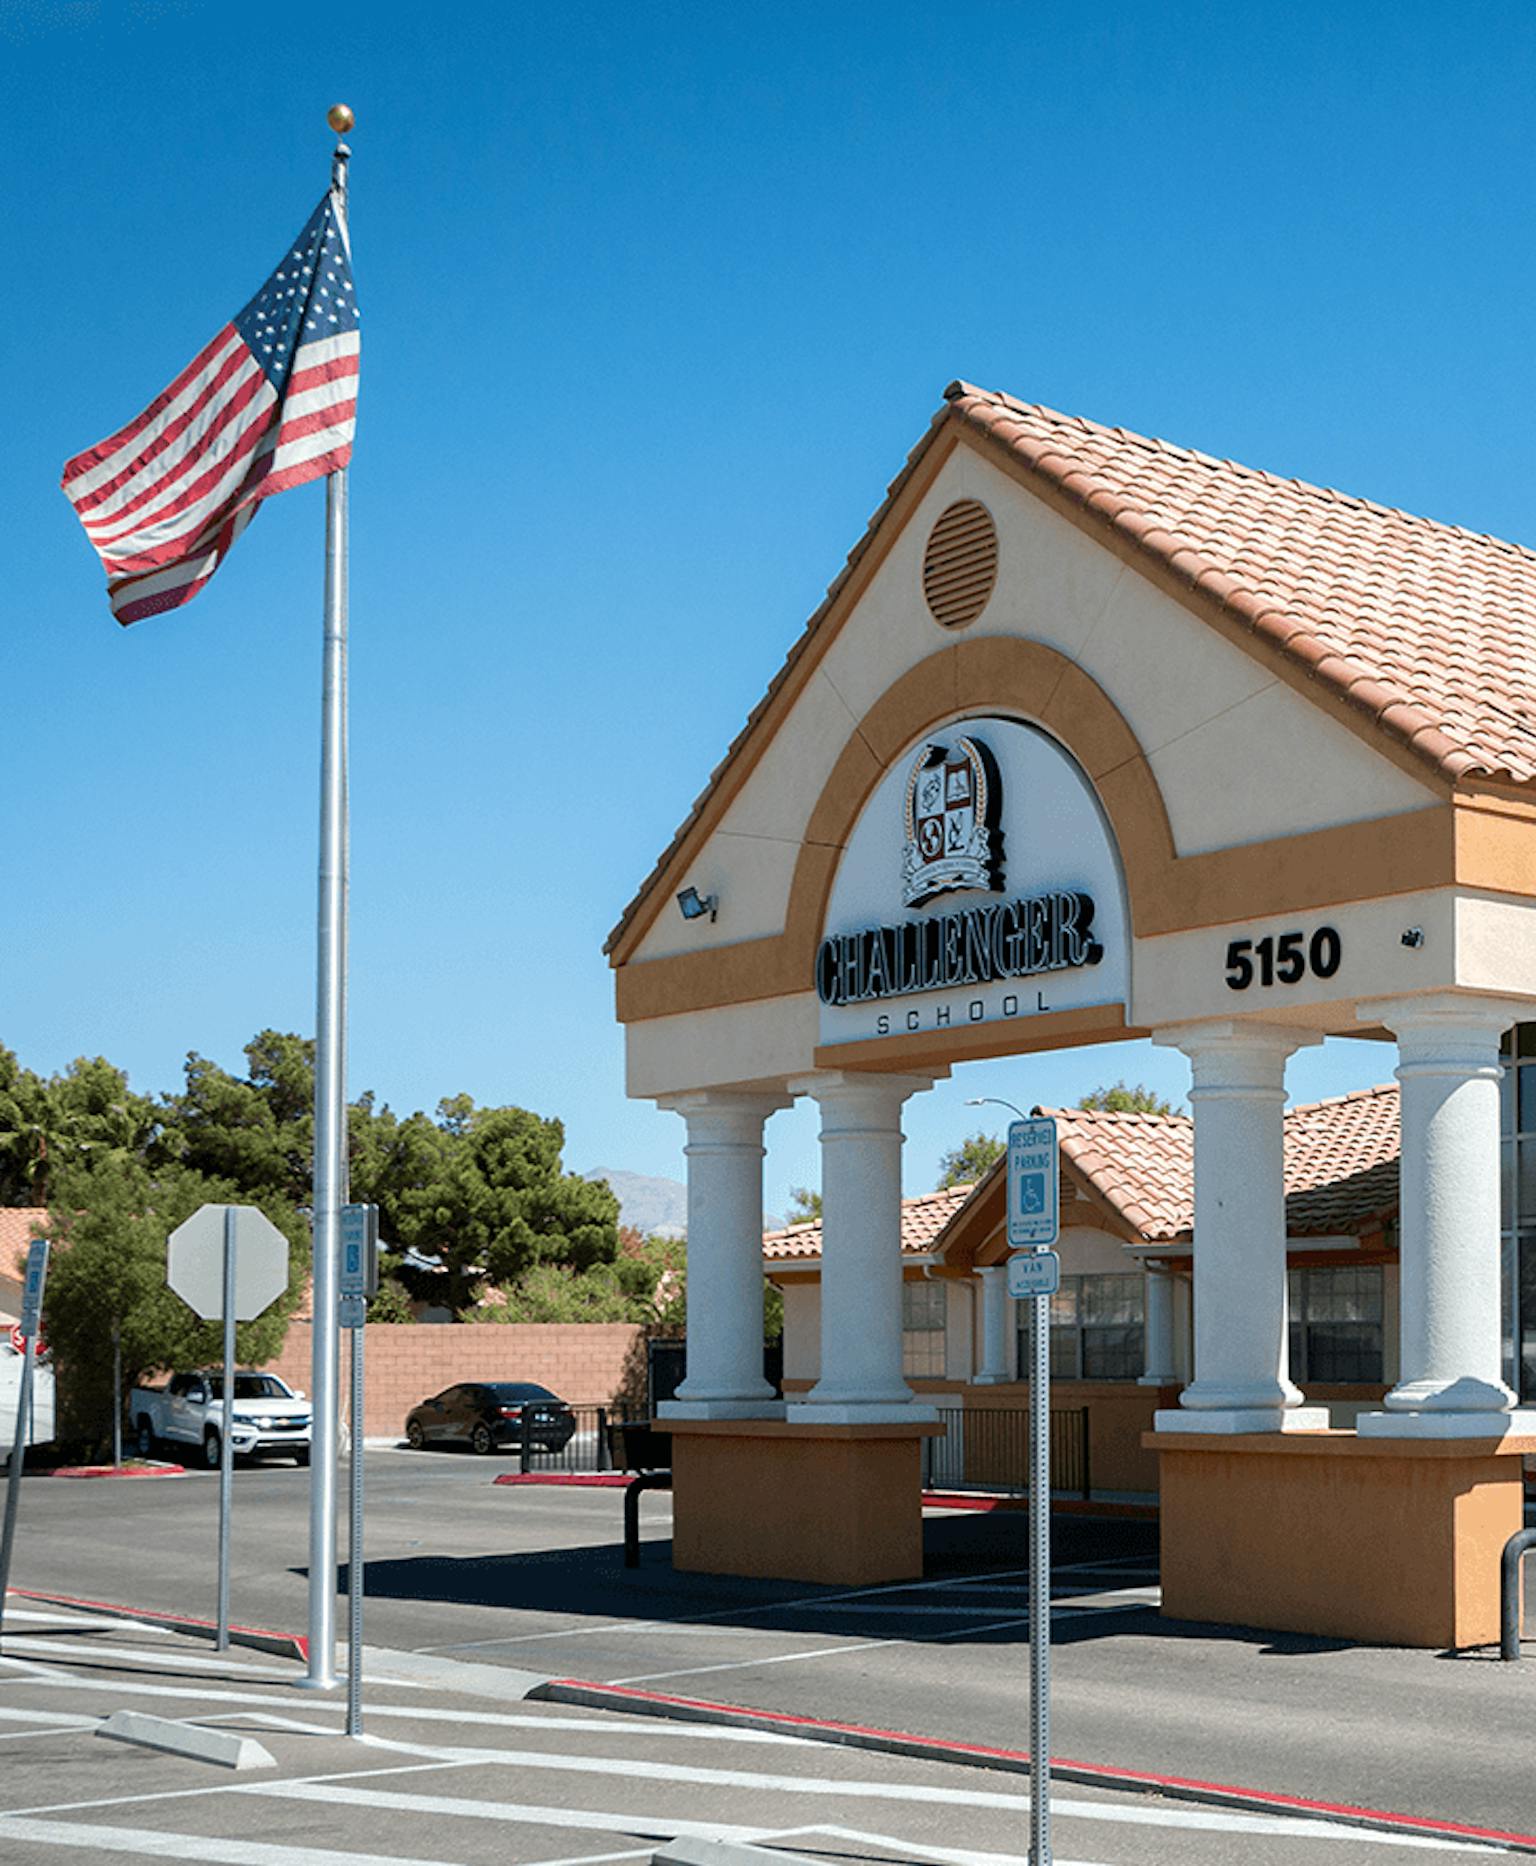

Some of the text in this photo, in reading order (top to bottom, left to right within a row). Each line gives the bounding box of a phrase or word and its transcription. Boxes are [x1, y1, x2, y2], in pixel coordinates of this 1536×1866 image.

[816, 890, 1102, 1006] CHALLENGER
[1225, 926, 1341, 990] 5150
[877, 991, 1049, 1035] SCHOOL
[1014, 1152, 1050, 1170] PARKING
[1023, 1262, 1042, 1273] VAN
